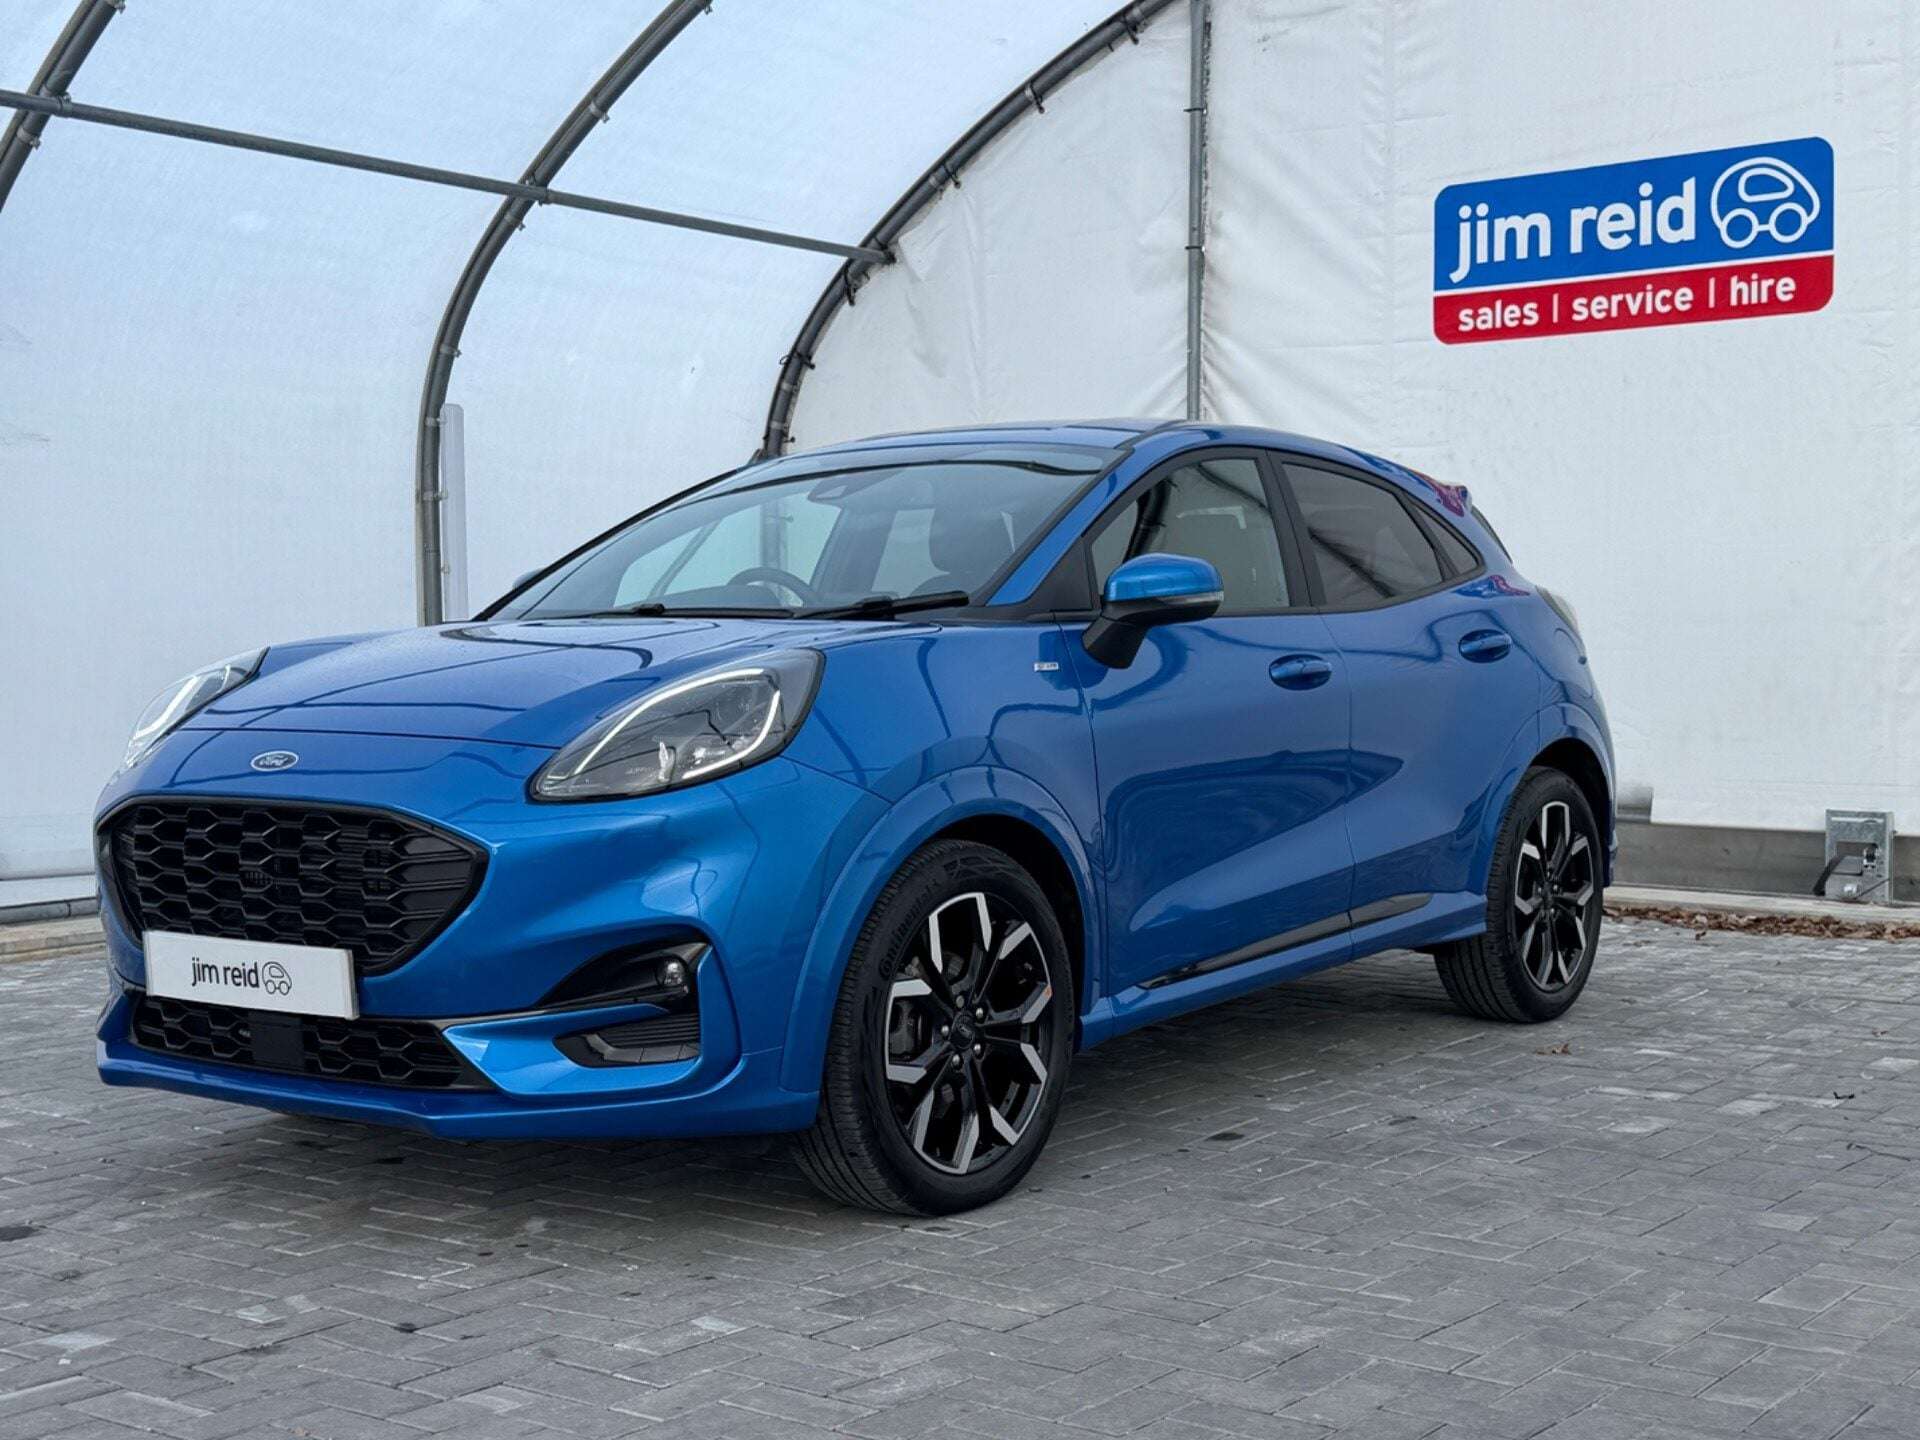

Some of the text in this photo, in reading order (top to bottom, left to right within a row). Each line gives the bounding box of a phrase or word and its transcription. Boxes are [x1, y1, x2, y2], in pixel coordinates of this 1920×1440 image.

[1449, 176, 1696, 284] jim reid
[1458, 299, 1540, 332] sales
[1571, 284, 1695, 321] service
[1729, 273, 1797, 306] hire
[191, 957, 260, 990] jim reid
